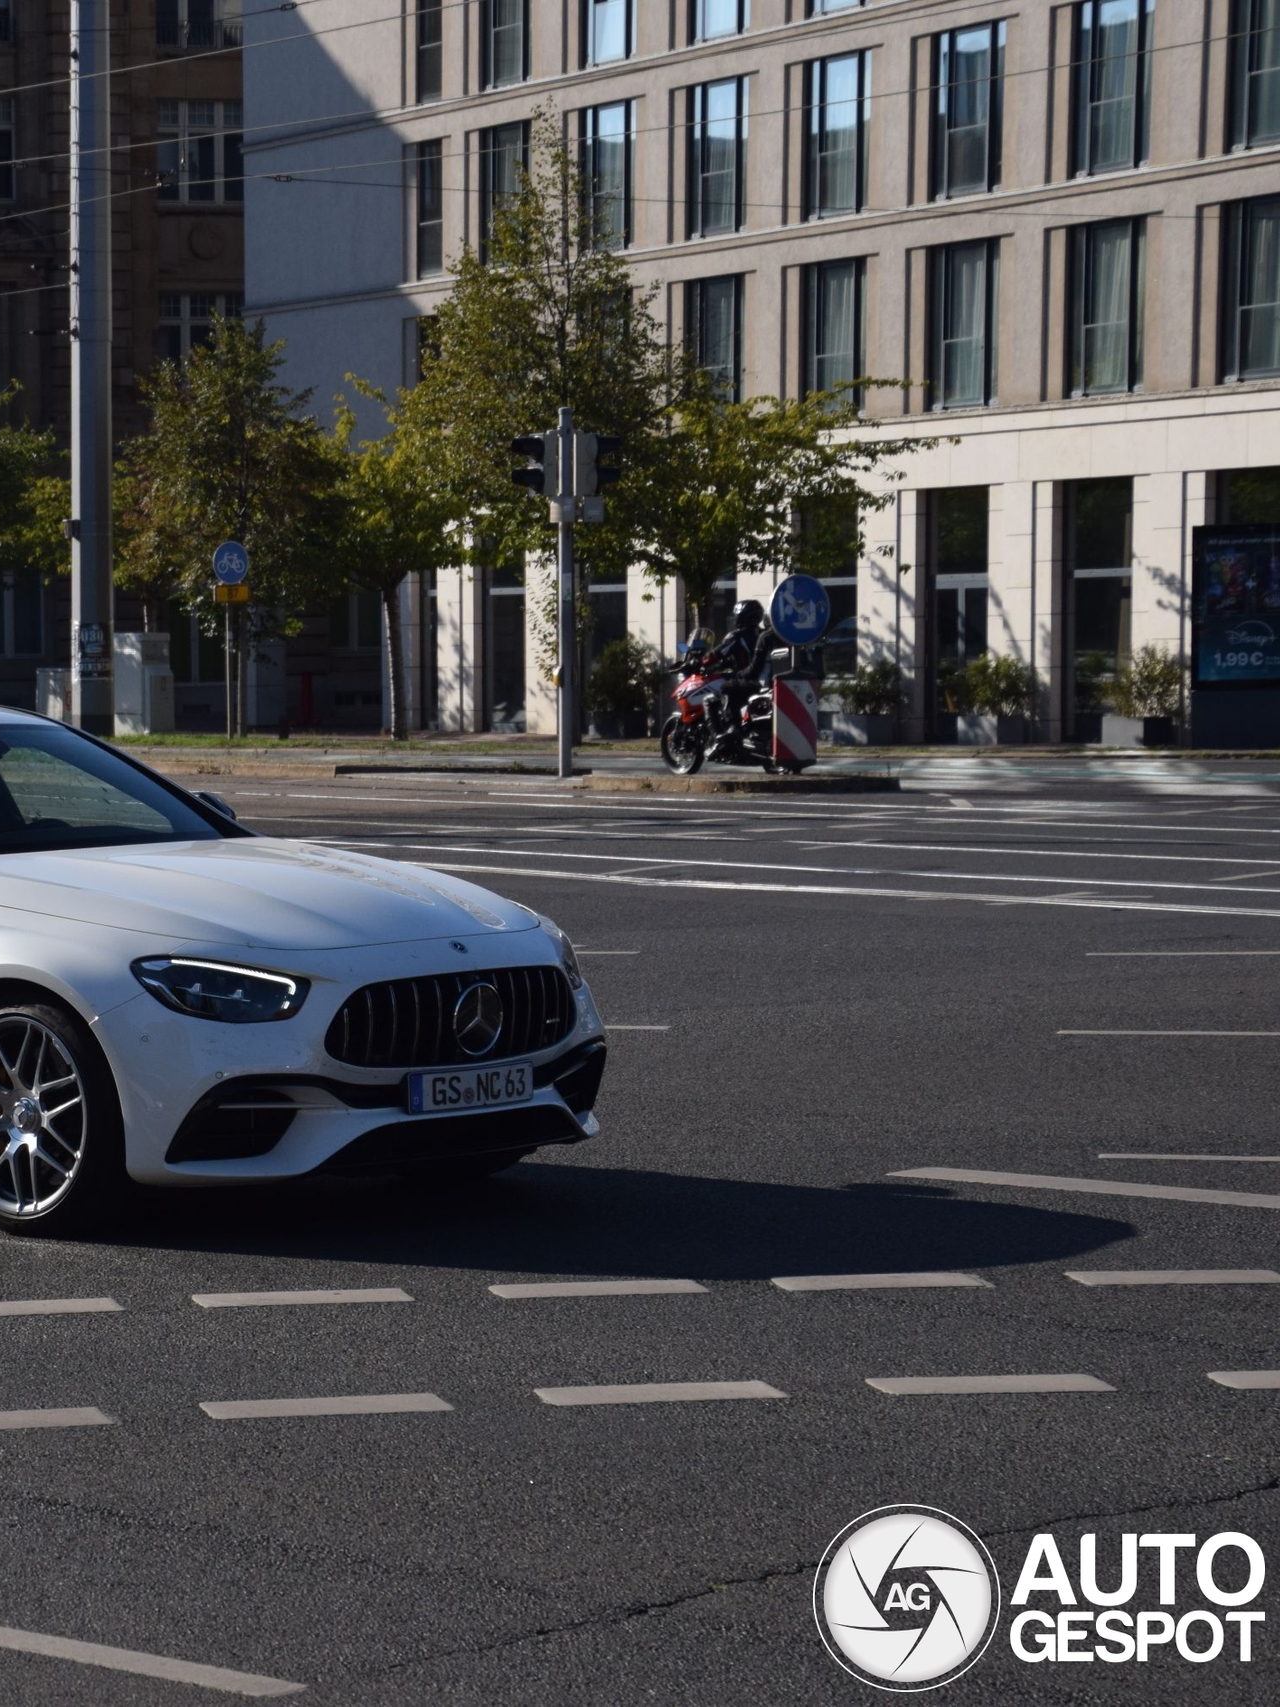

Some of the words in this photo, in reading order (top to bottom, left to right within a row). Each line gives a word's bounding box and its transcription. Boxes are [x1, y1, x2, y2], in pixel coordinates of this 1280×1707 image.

[432, 1076, 461, 1106] GS
[477, 1072, 500, 1101] NC
[505, 1068, 525, 1097] 63
